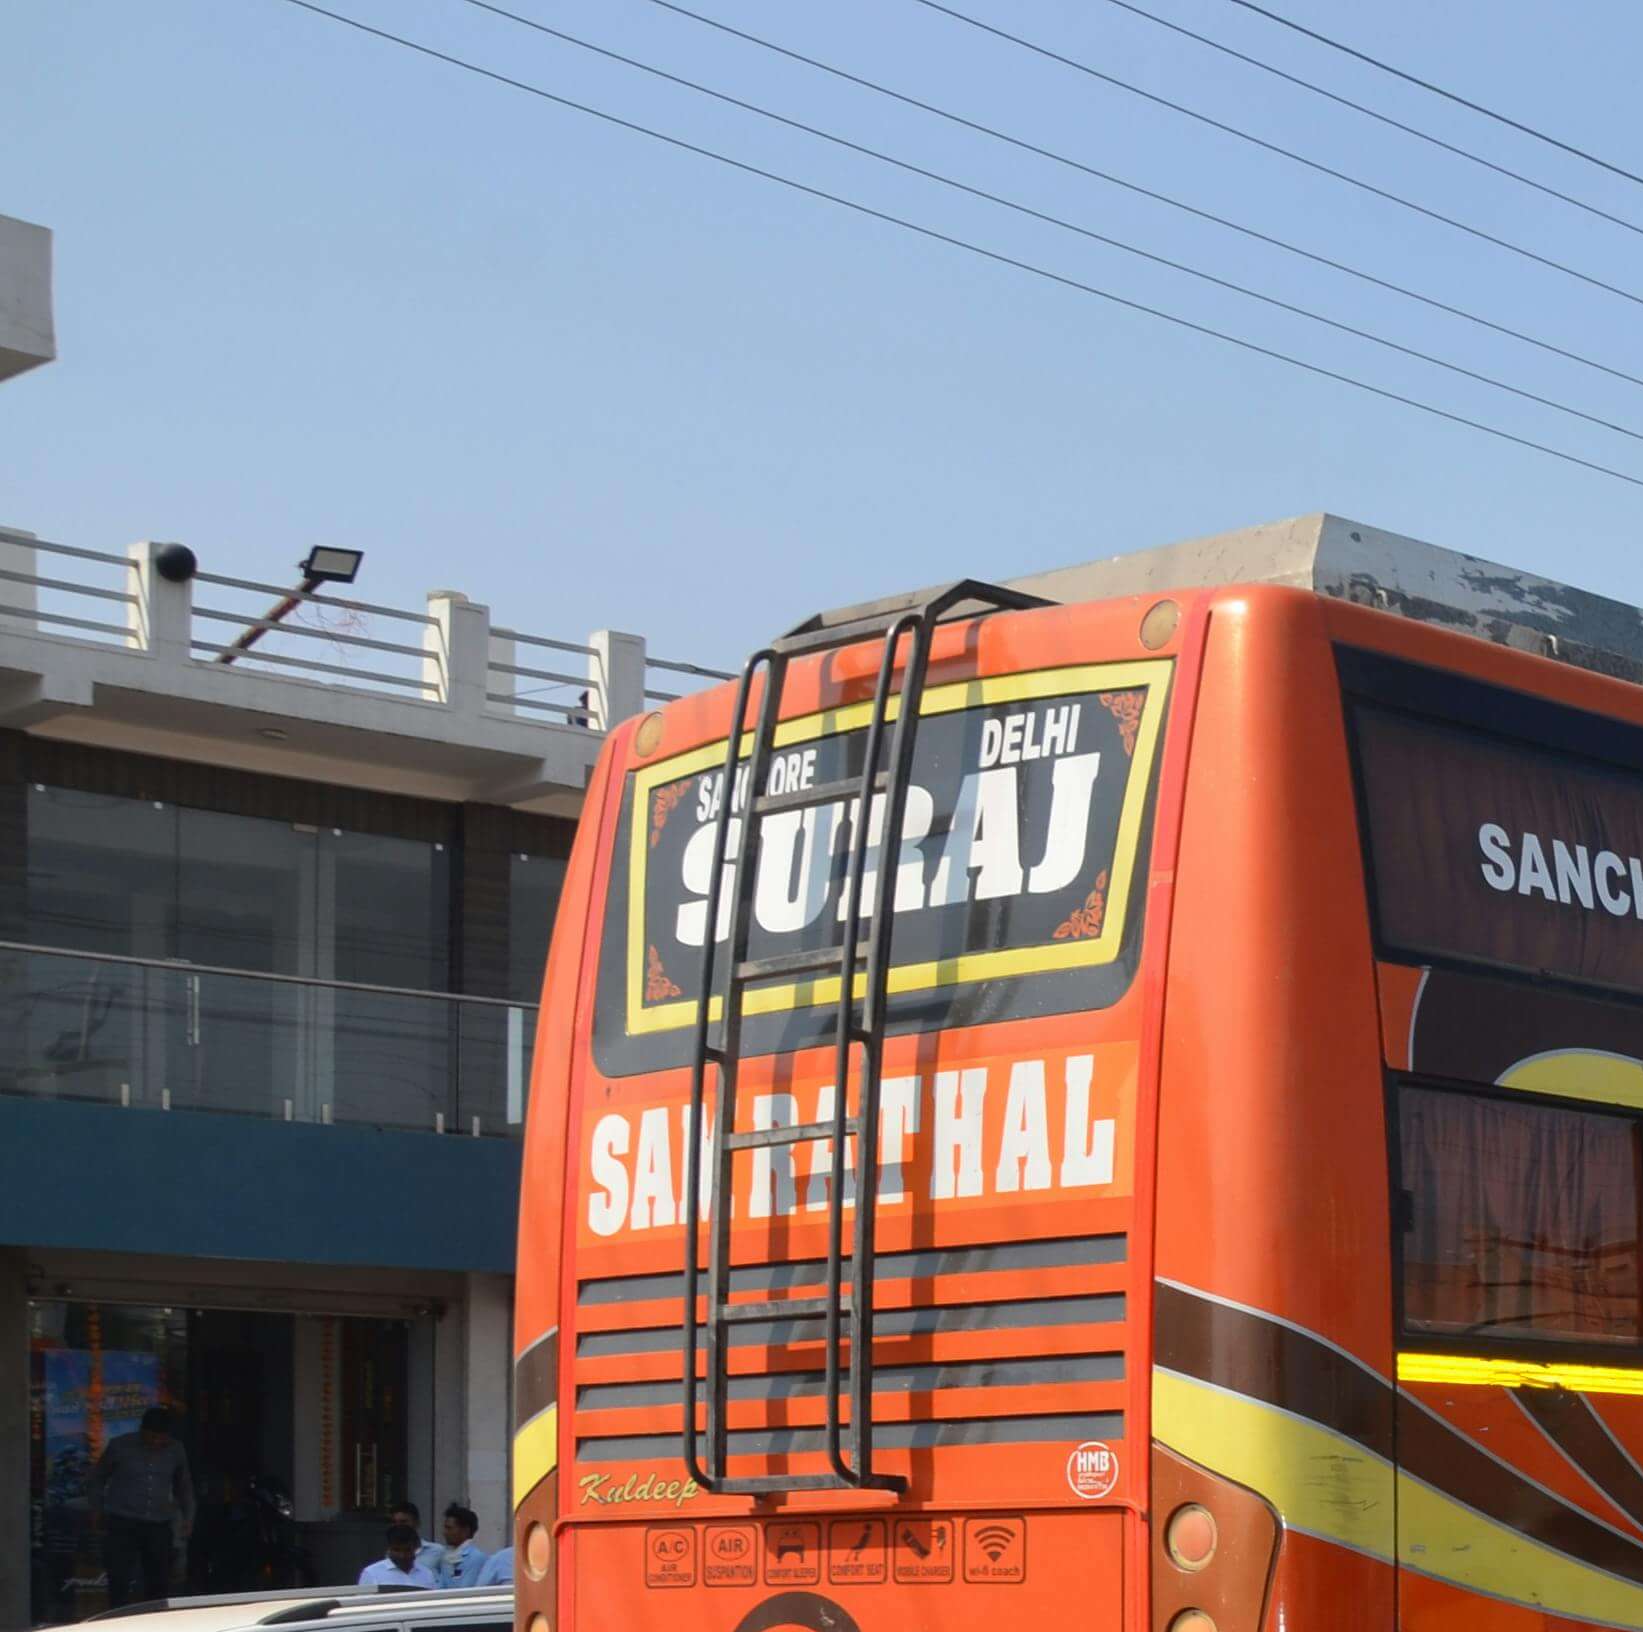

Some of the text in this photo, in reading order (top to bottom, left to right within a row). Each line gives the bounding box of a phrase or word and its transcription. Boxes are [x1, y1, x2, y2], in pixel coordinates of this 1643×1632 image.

[979, 704, 1082, 768] DELHI
[696, 750, 817, 822] SACORE
[676, 752, 1100, 946] SURAJ
[1077, 1451, 1110, 1472] HMB
[579, 1472, 699, 1507] Kuldeep
[718, 1537, 743, 1552] AIR
